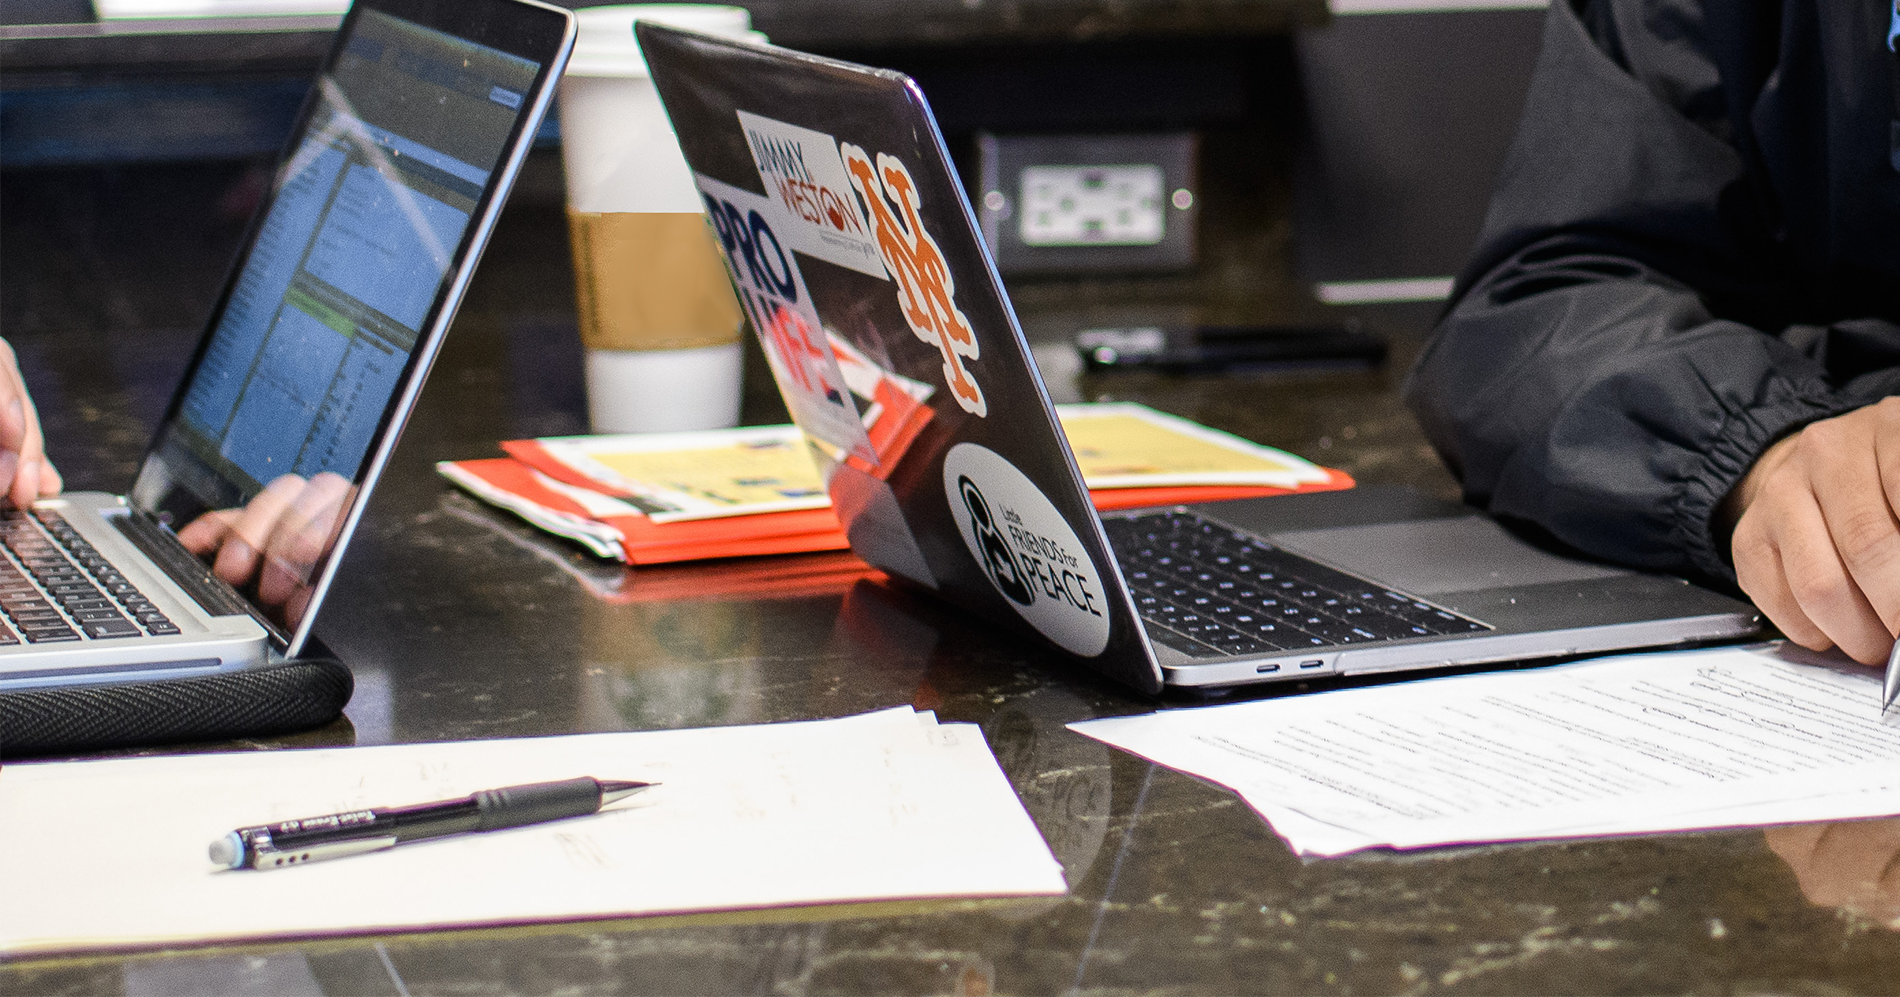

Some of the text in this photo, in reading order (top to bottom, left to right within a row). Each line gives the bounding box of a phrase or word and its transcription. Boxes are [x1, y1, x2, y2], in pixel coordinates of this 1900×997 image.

[748, 128, 811, 183] JIMMY
[771, 170, 864, 236] WESTON
[702, 190, 798, 304] PRO
[1008, 524, 1080, 569] FRIENDS For
[1019, 552, 1103, 618] PEACE
